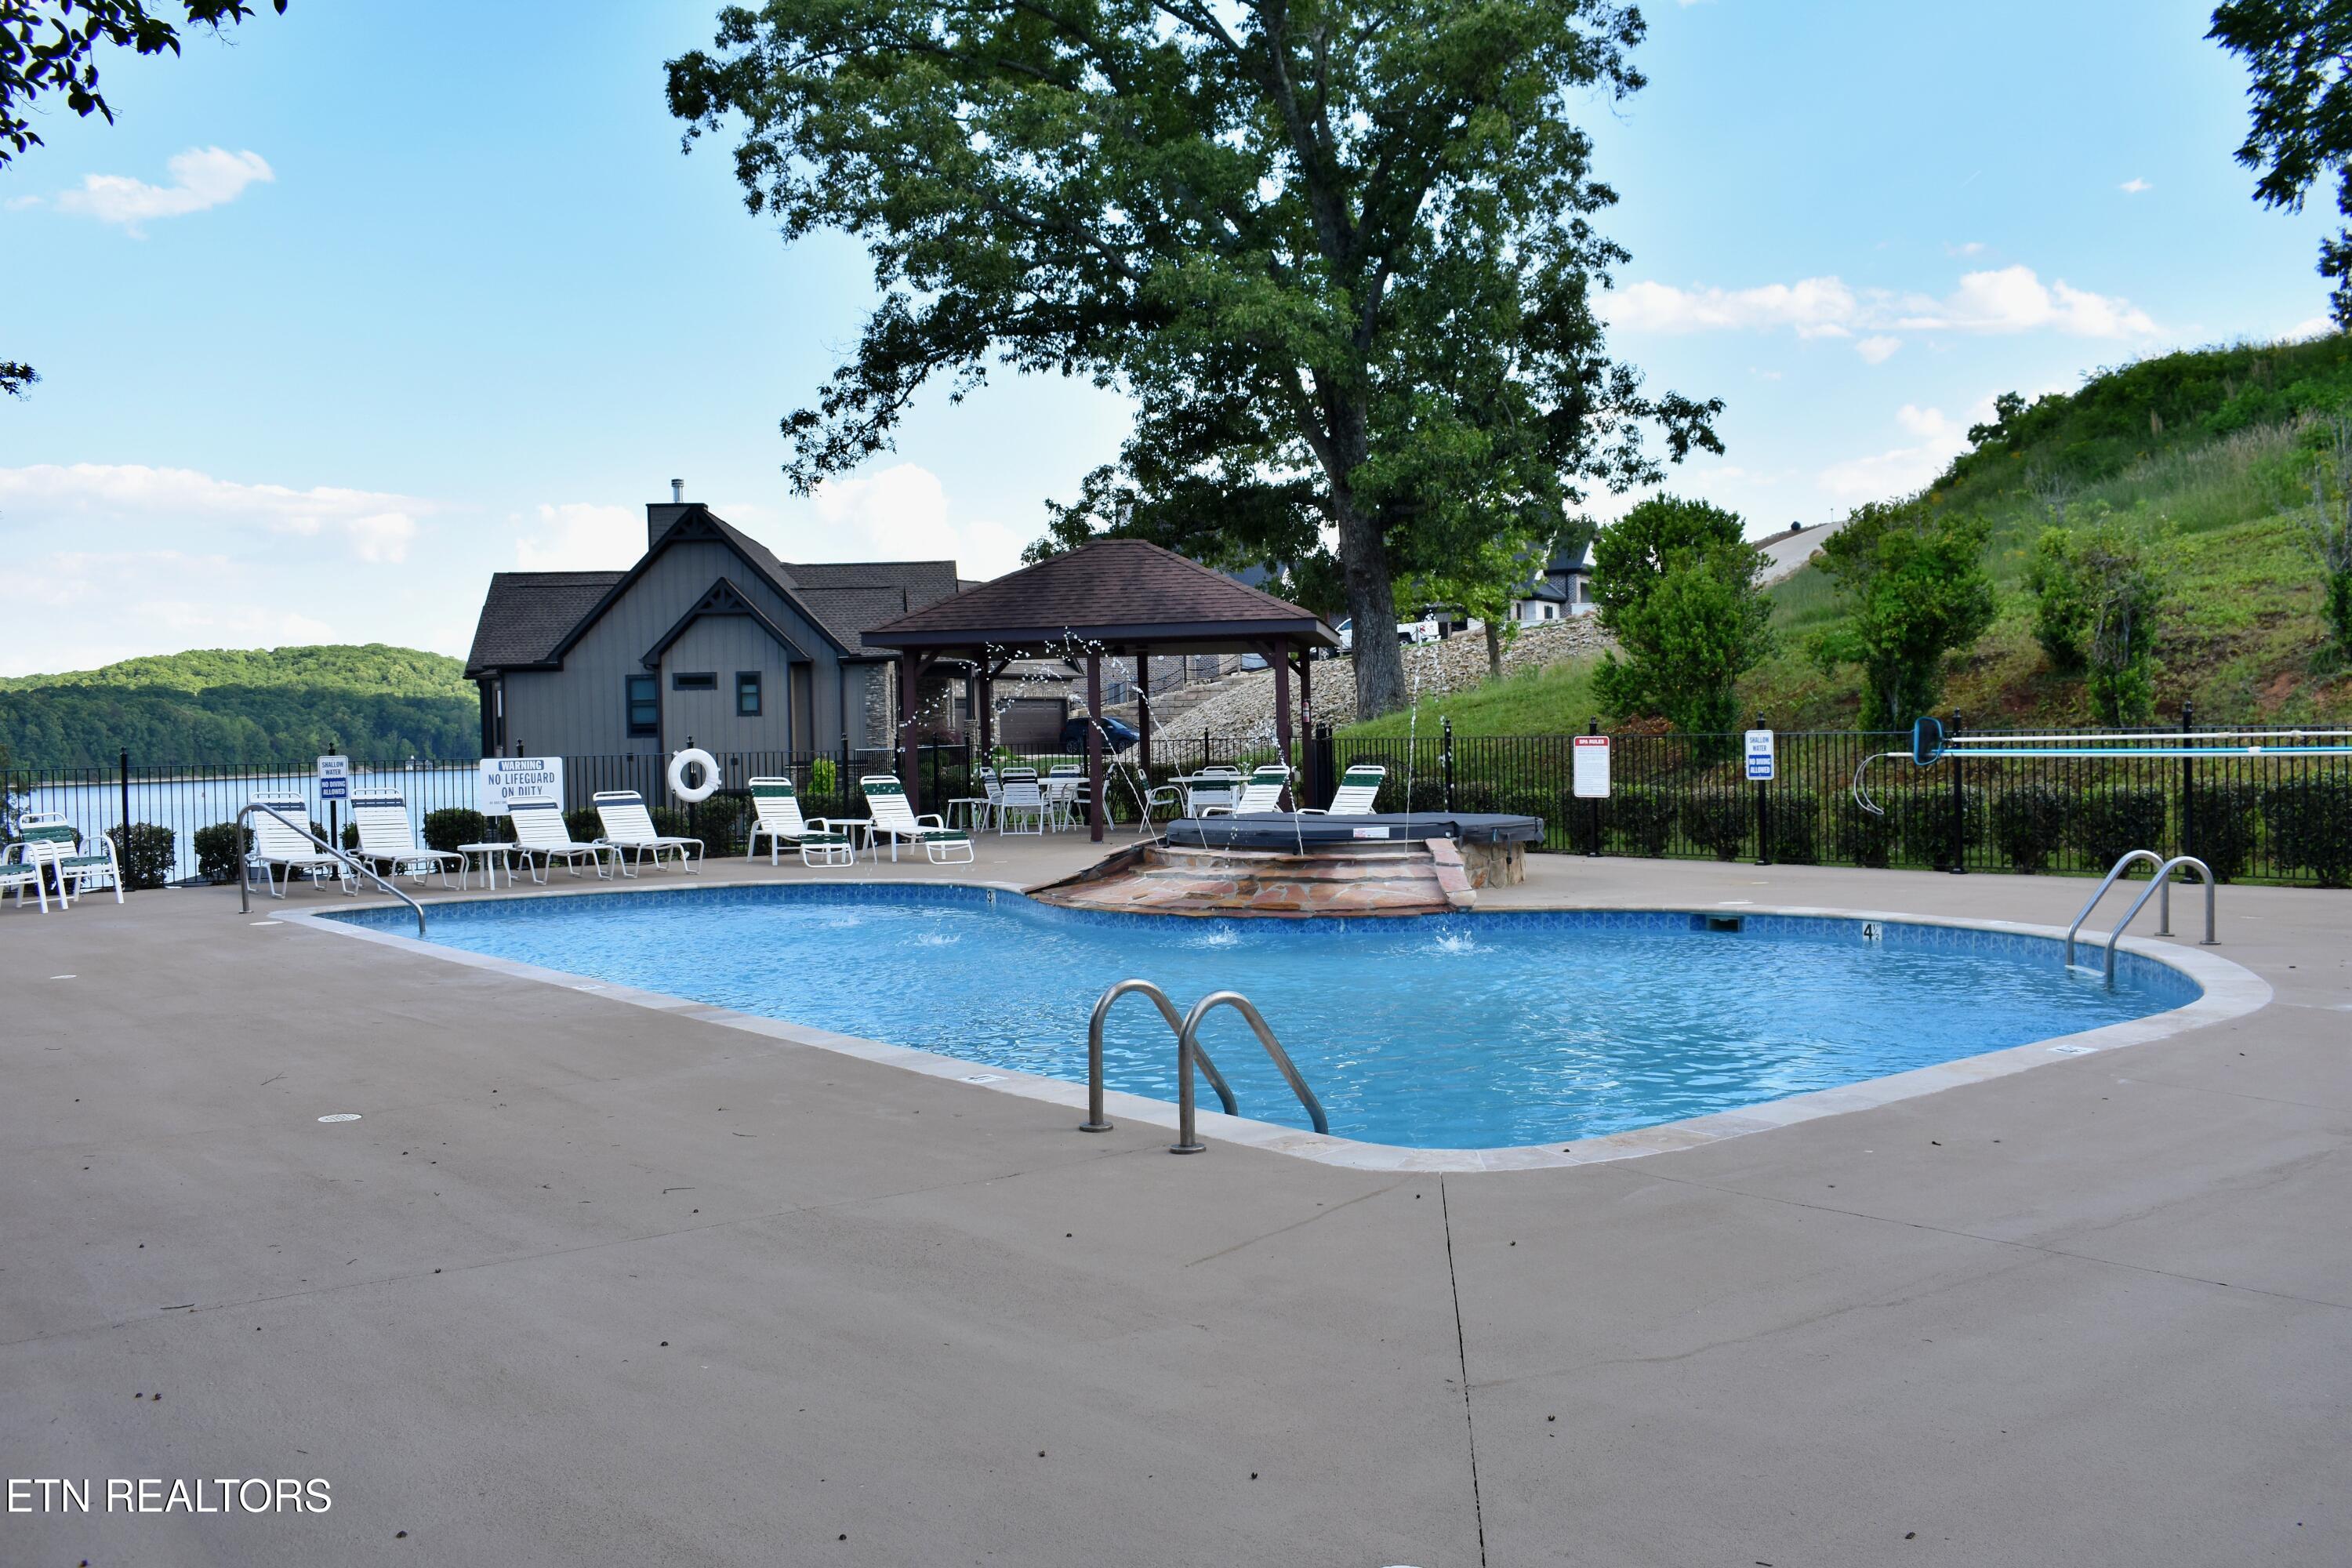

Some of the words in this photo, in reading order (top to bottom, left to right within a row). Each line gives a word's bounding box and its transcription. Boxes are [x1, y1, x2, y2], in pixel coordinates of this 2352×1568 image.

[501, 760, 543, 771] WARNING
[488, 774, 501, 785] NO
[505, 772, 555, 785] LIFEGUARD
[501, 786, 514, 798] ON
[518, 786, 543, 797] DUTY
